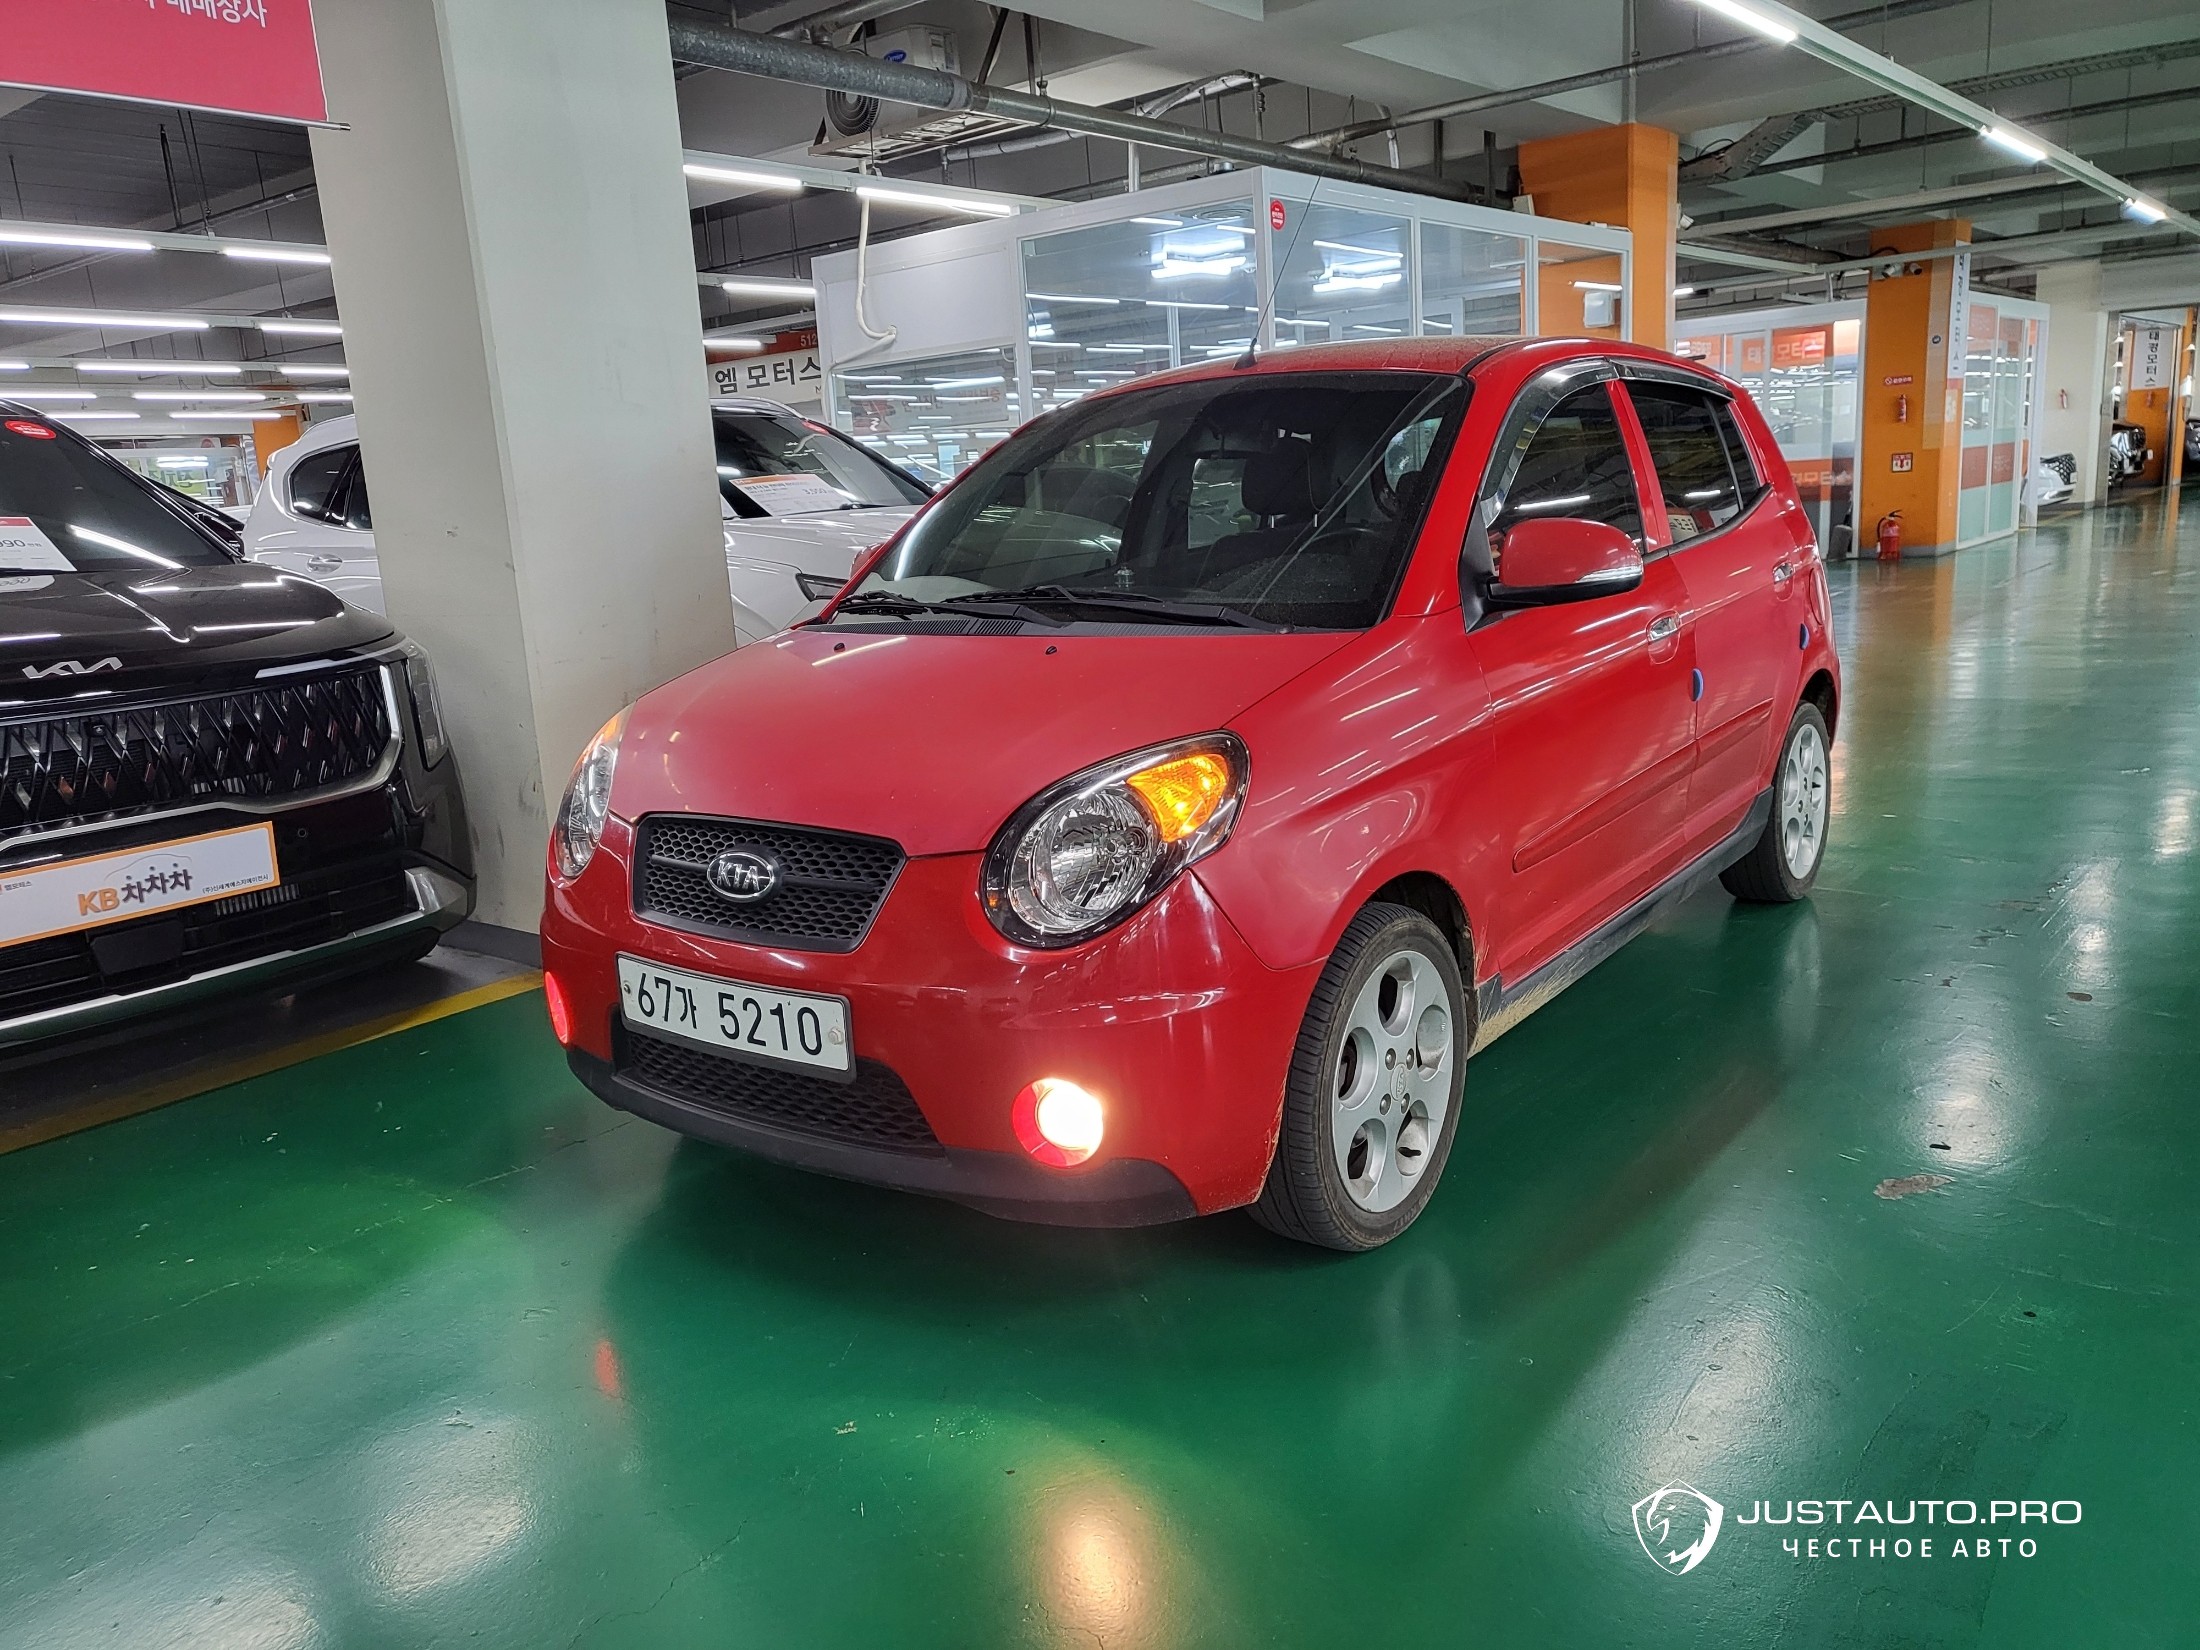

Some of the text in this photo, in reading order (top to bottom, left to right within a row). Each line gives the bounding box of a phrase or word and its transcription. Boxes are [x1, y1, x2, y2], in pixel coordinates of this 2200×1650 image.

[746, 356, 822, 389] 모터스
[716, 860, 760, 891] KIA
[637, 972, 823, 1056] 67가 5210
